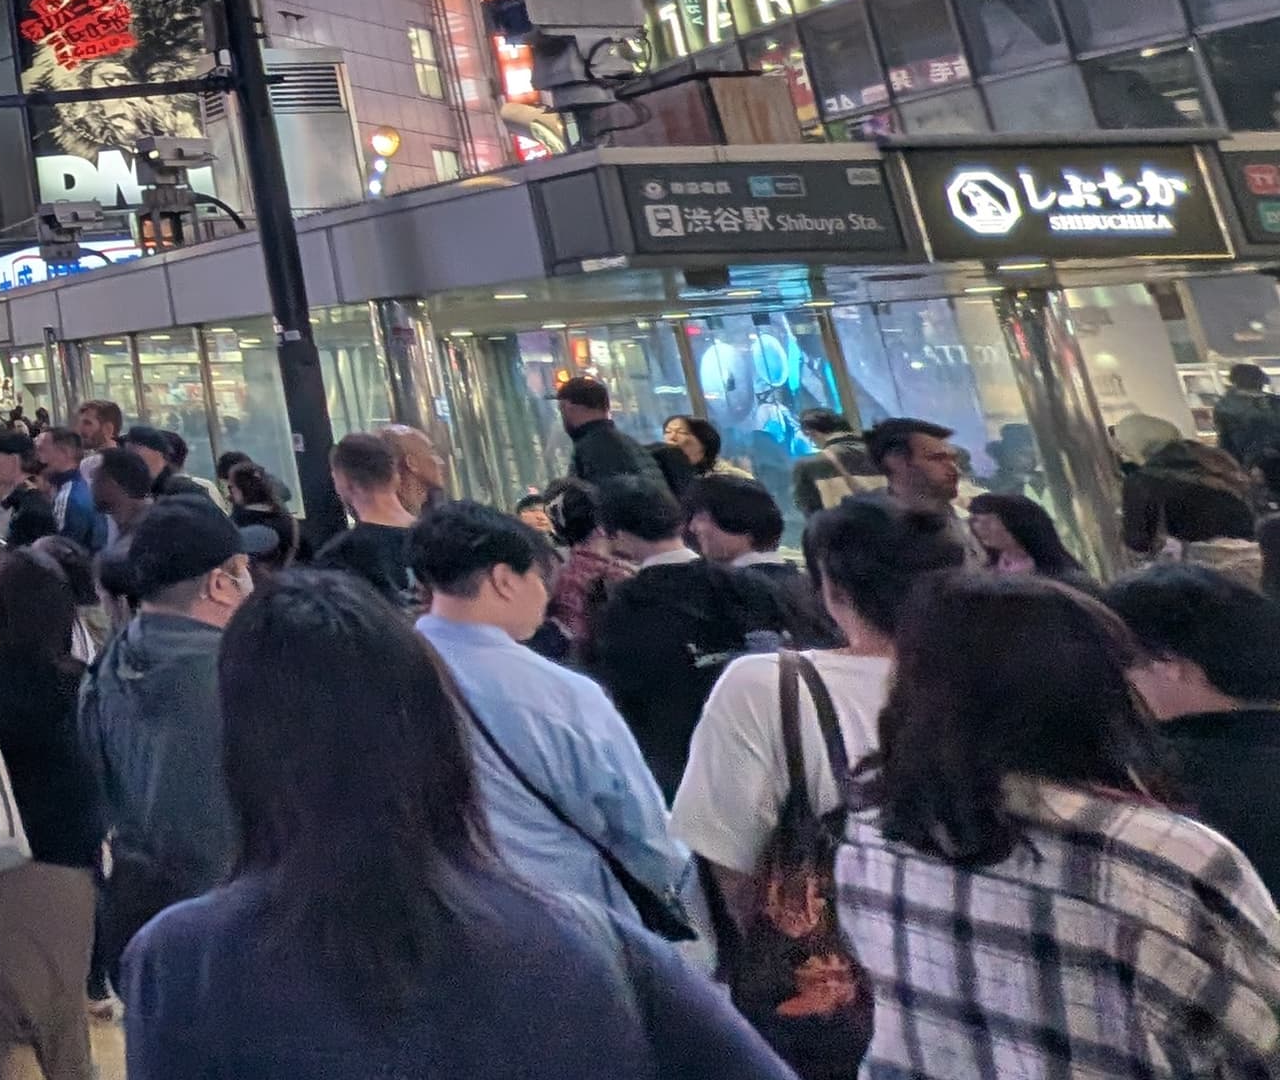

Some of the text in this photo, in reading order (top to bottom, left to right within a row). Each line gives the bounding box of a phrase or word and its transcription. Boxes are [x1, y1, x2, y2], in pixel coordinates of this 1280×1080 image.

[1018, 168, 1189, 210] しぶちか
[683, 206, 886, 235] 渋谷駅 Shibuya Sta.
[1048, 213, 1176, 231] SHIBUCHIKA
